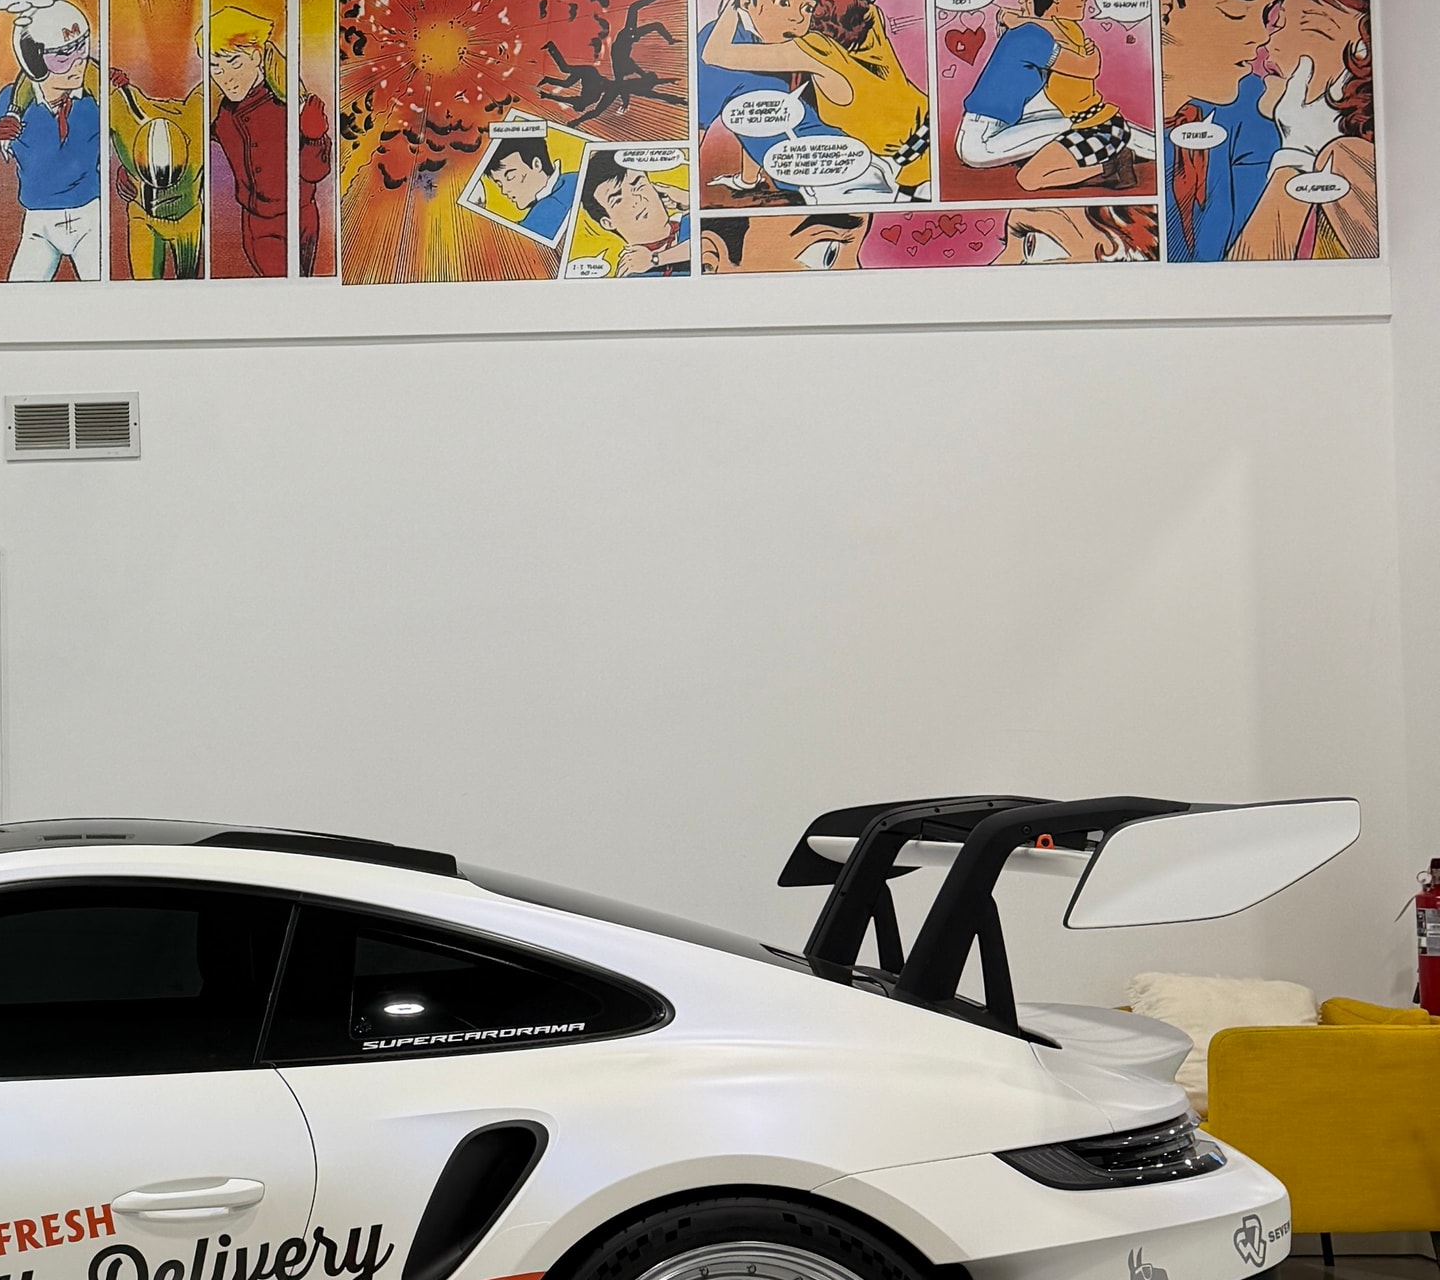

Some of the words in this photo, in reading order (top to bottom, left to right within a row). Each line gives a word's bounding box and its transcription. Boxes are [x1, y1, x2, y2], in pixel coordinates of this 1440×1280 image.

[748, 107, 781, 116] SORRY
[764, 114, 790, 122] DOWN!
[362, 1022, 586, 1050] SUPERCARDRAMA
